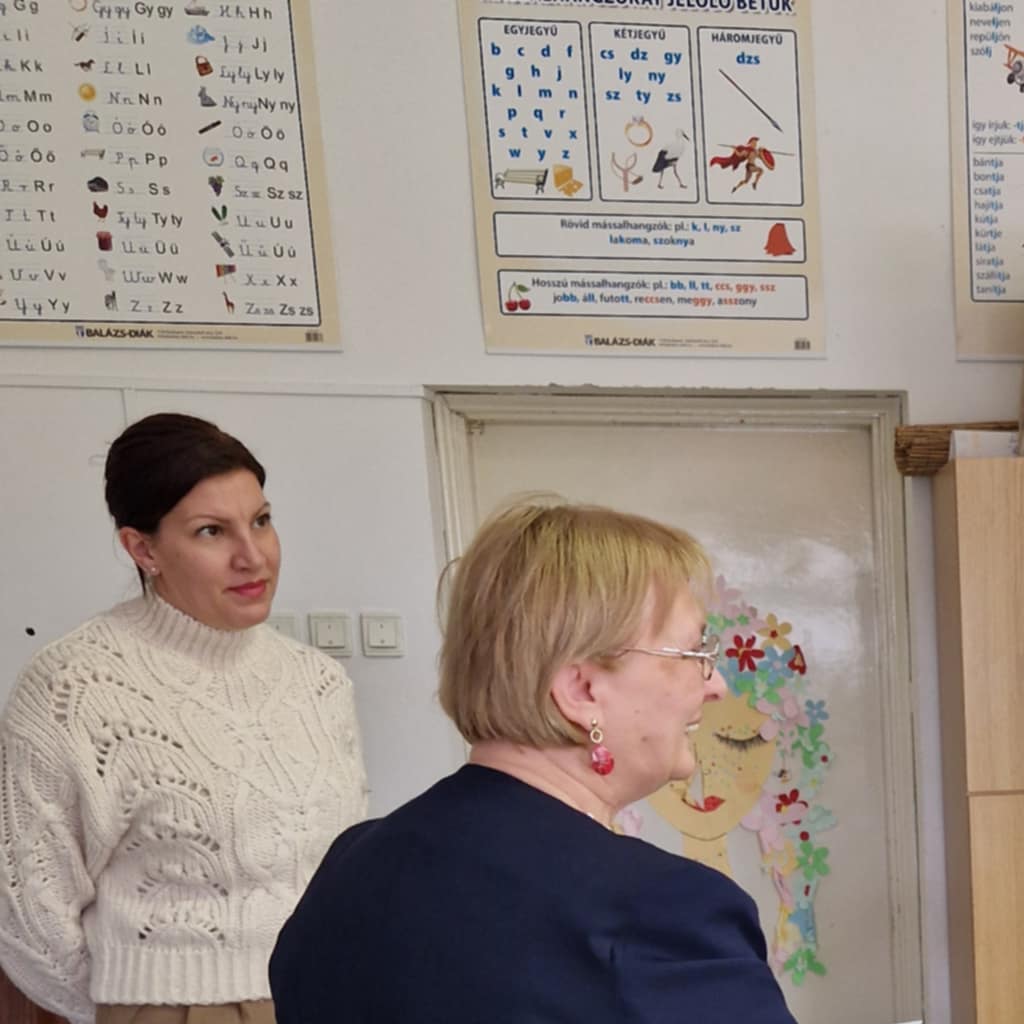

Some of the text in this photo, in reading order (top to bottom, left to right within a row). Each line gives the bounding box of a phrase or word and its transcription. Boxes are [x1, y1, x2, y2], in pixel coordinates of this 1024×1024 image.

[491, 42, 573, 58] b c d f
[600, 48, 682, 65] cs dz gy
[736, 52, 760, 65] dzs
[20, 60, 31, 72] K
[505, 64, 562, 81] g h j
[255, 67, 270, 82] Ly
[619, 67, 666, 85] ly ny
[24, 90, 52, 102] M m
[492, 84, 578, 99] k l m n
[606, 90, 682, 104] sz ty zs
[139, 93, 162, 105] N n
[258, 98, 295, 114] Ny ny
[508, 108, 565, 121] p q r
[498, 127, 577, 139] s t v x
[145, 153, 155, 165] P
[509, 149, 569, 161] w y z
[264, 157, 276, 170] Q
[267, 187, 303, 200] Sz sz
[152, 212, 168, 228] Ty
[560, 219, 589, 229] Rövid
[609, 234, 695, 247] lakoma, szoknya
[44, 269, 54, 281] V
[158, 272, 188, 284] W w
[531, 278, 568, 288] Hosszú
[760, 284, 776, 292] ssz
[162, 301, 171, 314] Z
[717, 298, 757, 307] asszony
[279, 304, 314, 316] Zs zs
